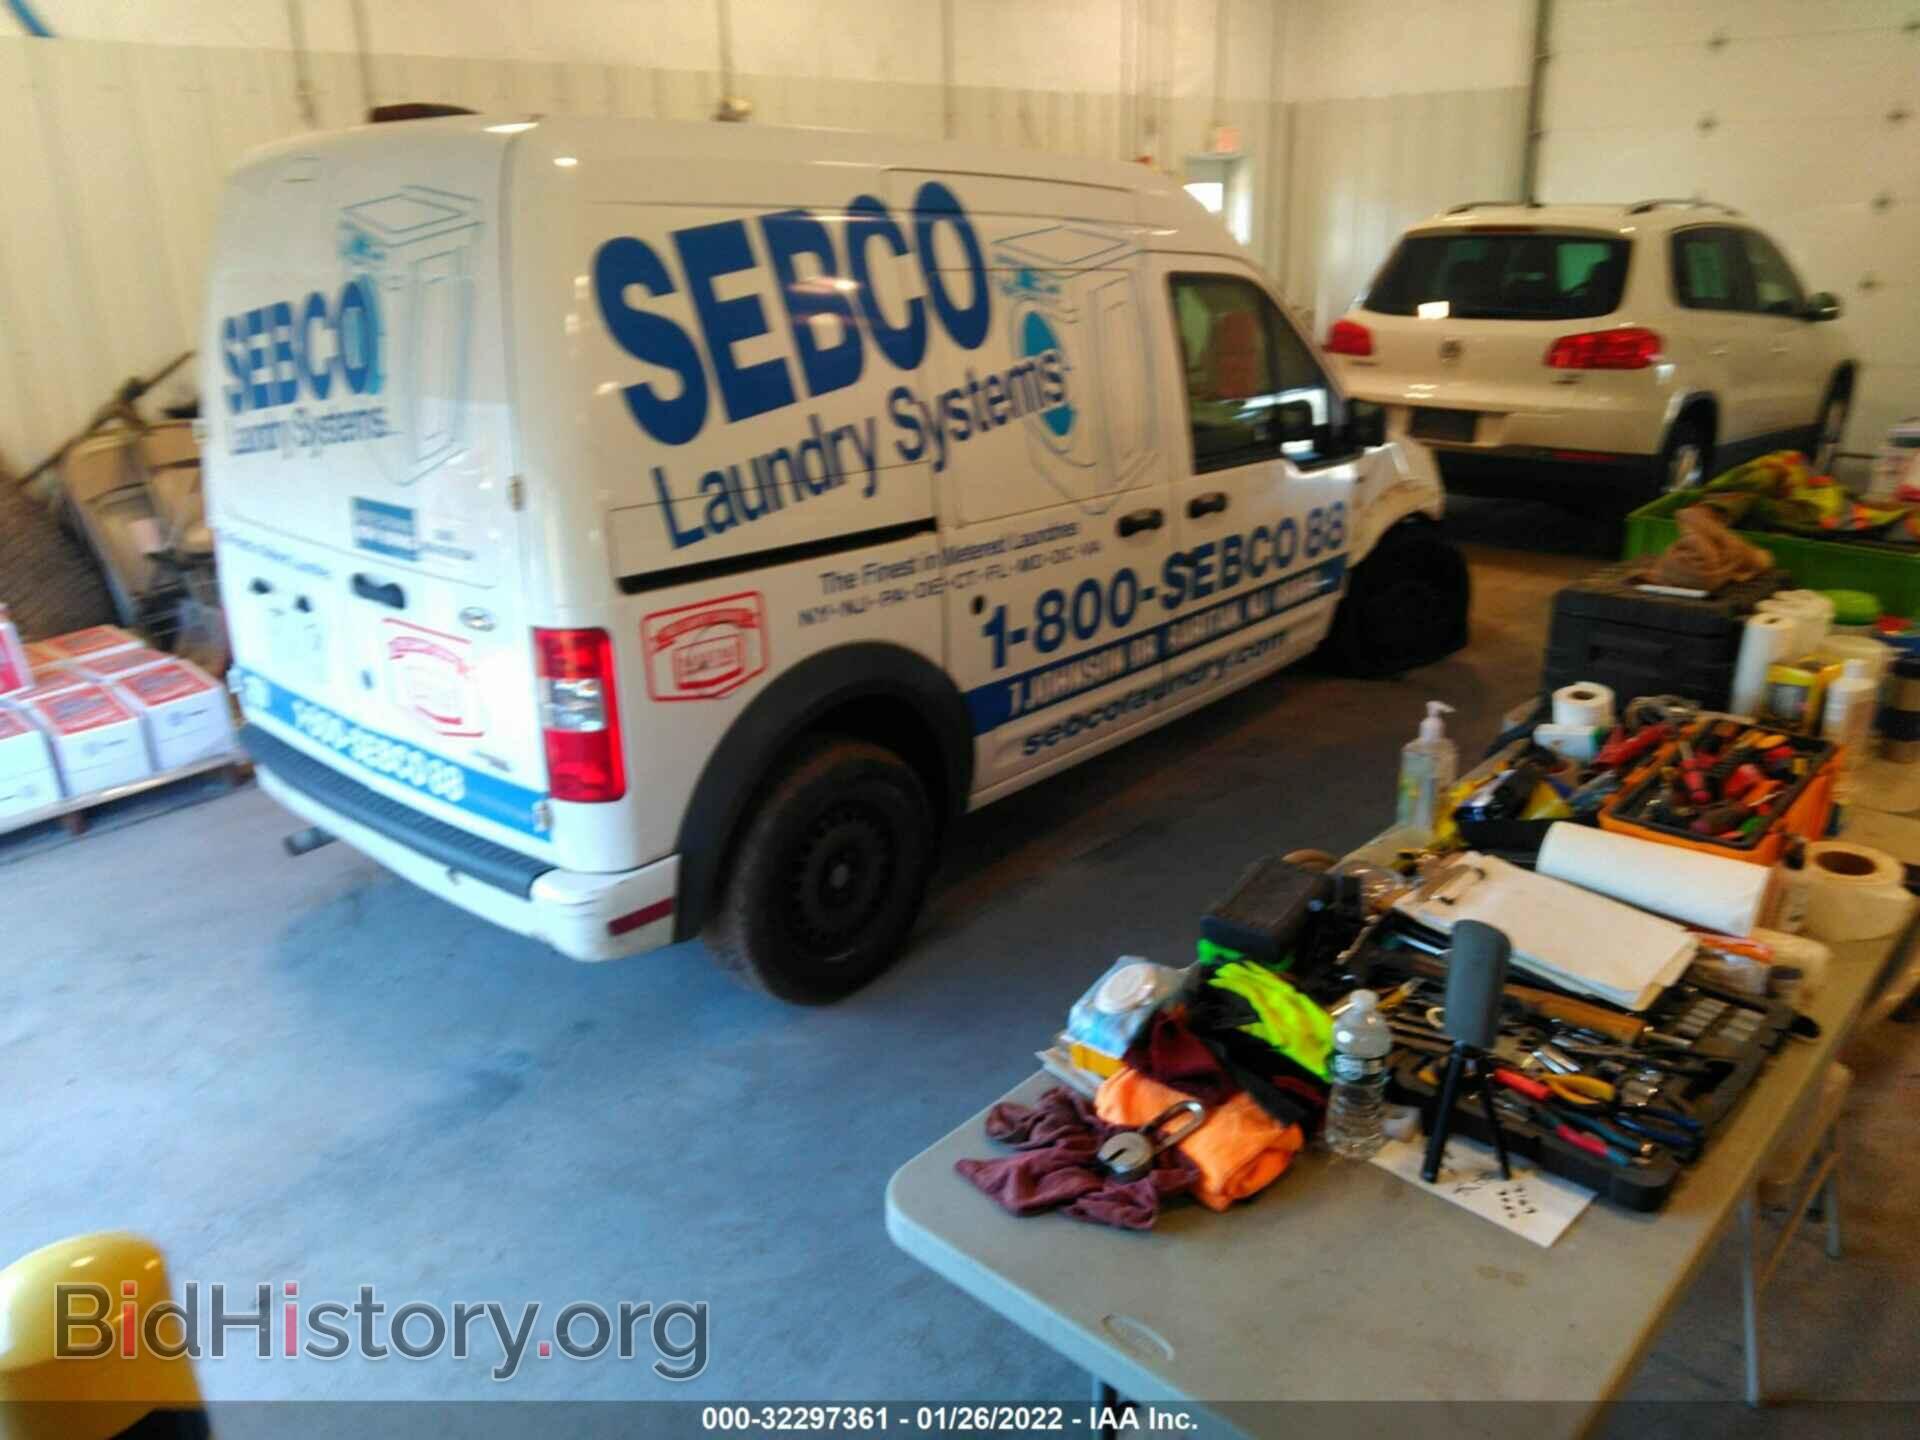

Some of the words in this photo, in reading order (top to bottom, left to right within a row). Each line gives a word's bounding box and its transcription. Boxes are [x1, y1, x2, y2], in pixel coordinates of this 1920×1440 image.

[222, 280, 373, 414] SEBCO
[591, 181, 990, 446] SEBCO
[650, 413, 877, 549] Laundry
[886, 351, 1070, 473] Systems
[819, 571, 857, 595] The
